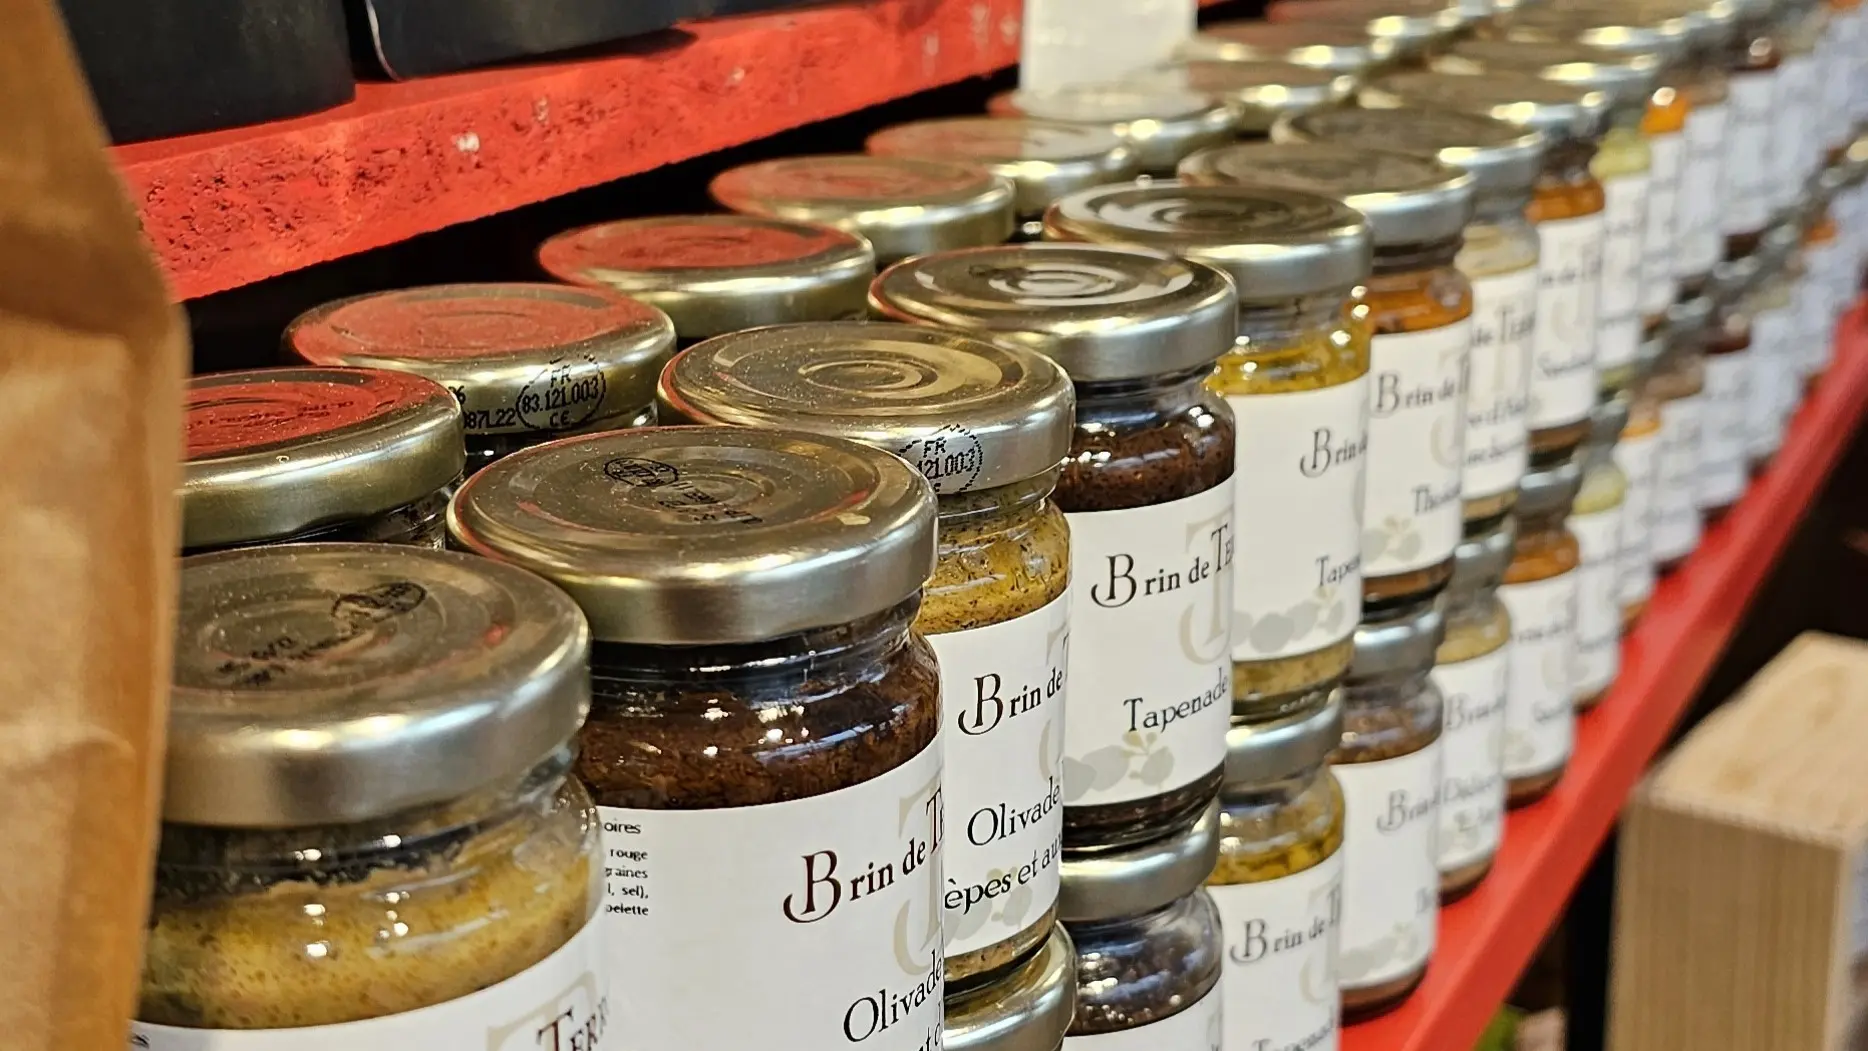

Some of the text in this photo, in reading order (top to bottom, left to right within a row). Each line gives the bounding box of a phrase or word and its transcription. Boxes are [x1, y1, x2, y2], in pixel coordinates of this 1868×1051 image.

[551, 363, 572, 388] FR
[1369, 373, 1433, 419] Brin
[916, 446, 976, 481] 121.003
[923, 436, 947, 458] FR
[1300, 427, 1358, 479] Brin
[1090, 523, 1234, 608] Brin de TE
[957, 672, 1041, 736] Brin
[1046, 666, 1063, 700] de
[1122, 666, 1229, 733] Tapenade
[603, 817, 642, 835] oires
[966, 775, 1061, 847] Olivade
[783, 850, 894, 924] Brin
[902, 836, 926, 876] de
[944, 876, 1011, 916] èpes
[1017, 848, 1038, 885] et
[1229, 918, 1304, 967] Brin
[843, 948, 943, 1042] Olivade
